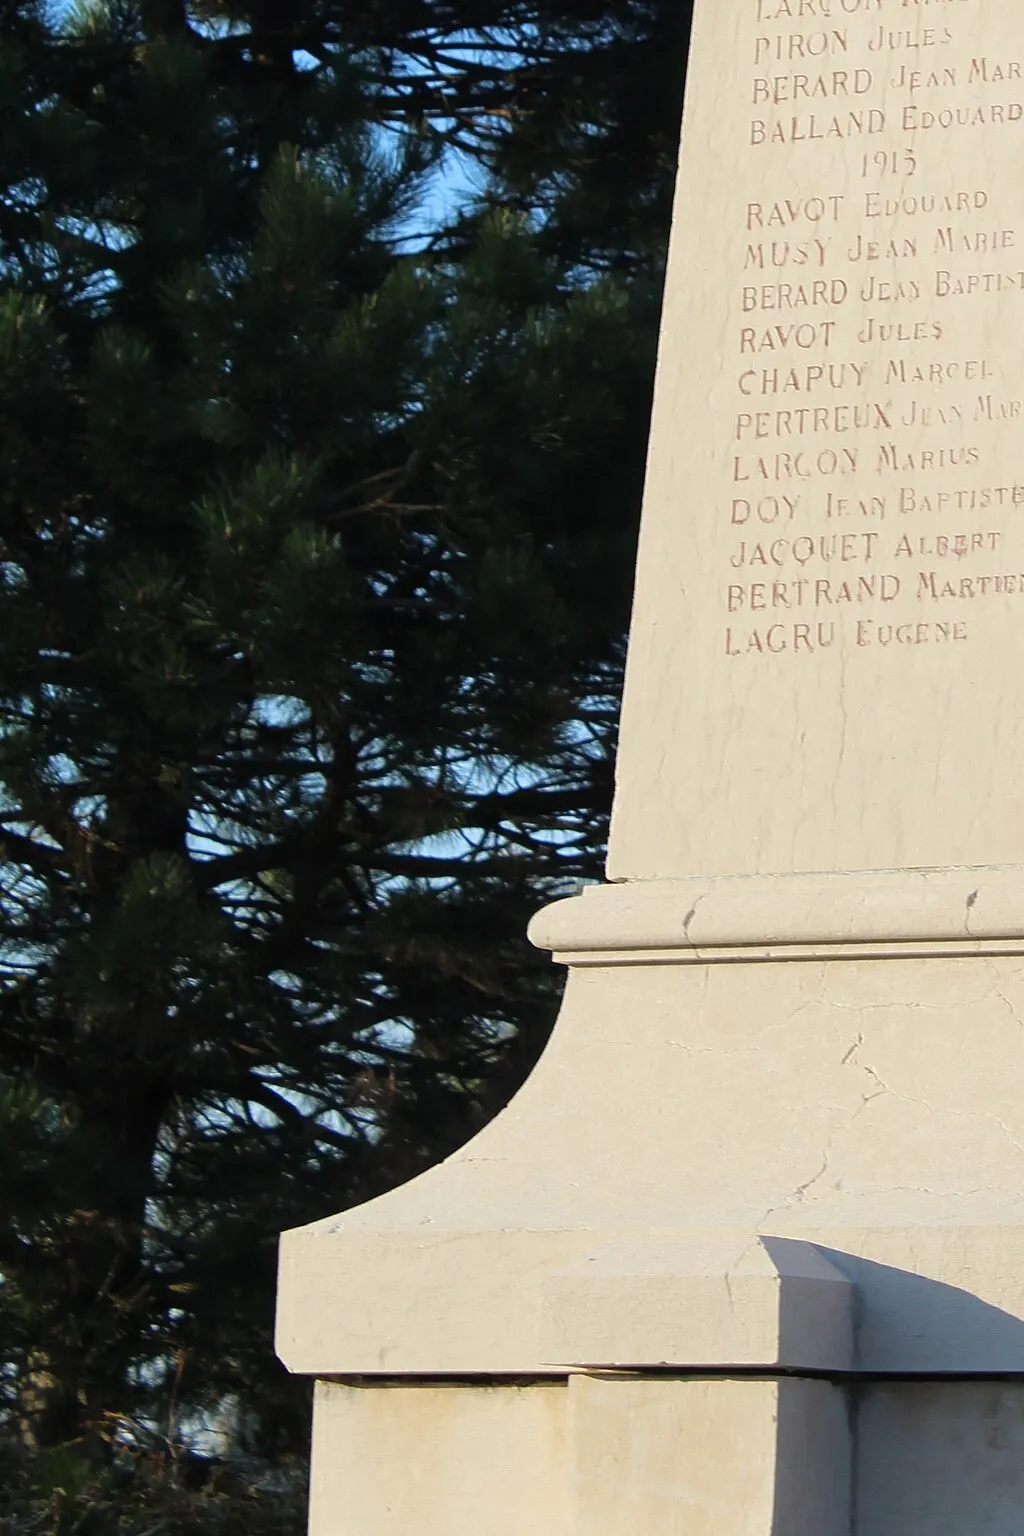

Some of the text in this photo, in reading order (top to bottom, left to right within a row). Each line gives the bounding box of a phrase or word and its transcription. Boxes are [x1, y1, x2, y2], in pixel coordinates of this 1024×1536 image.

[754, 26, 952, 64] PIRON JULES
[752, 69, 872, 104] BERARD
[890, 65, 957, 91] JEAN
[750, 103, 1024, 146] BALLAND EDOUARD
[862, 148, 917, 177] 1915
[747, 190, 988, 231] RAVOT EDOUARD
[744, 227, 1016, 270] MUSY JEAN MARIE
[742, 279, 848, 312] BERARD
[860, 276, 922, 304] JEAN
[740, 318, 944, 354] RAVOT JULES
[738, 359, 994, 396] CHAPUY MARCEL
[736, 402, 893, 441] PERTREUX
[901, 401, 964, 427] JEAN
[877, 443, 980, 475] MARIUS
[730, 495, 801, 526] DOY
[730, 532, 1002, 569] JACQUET ALBERT
[727, 574, 901, 613] BERTRAND
[725, 619, 968, 656] LAGRU EUGENE
